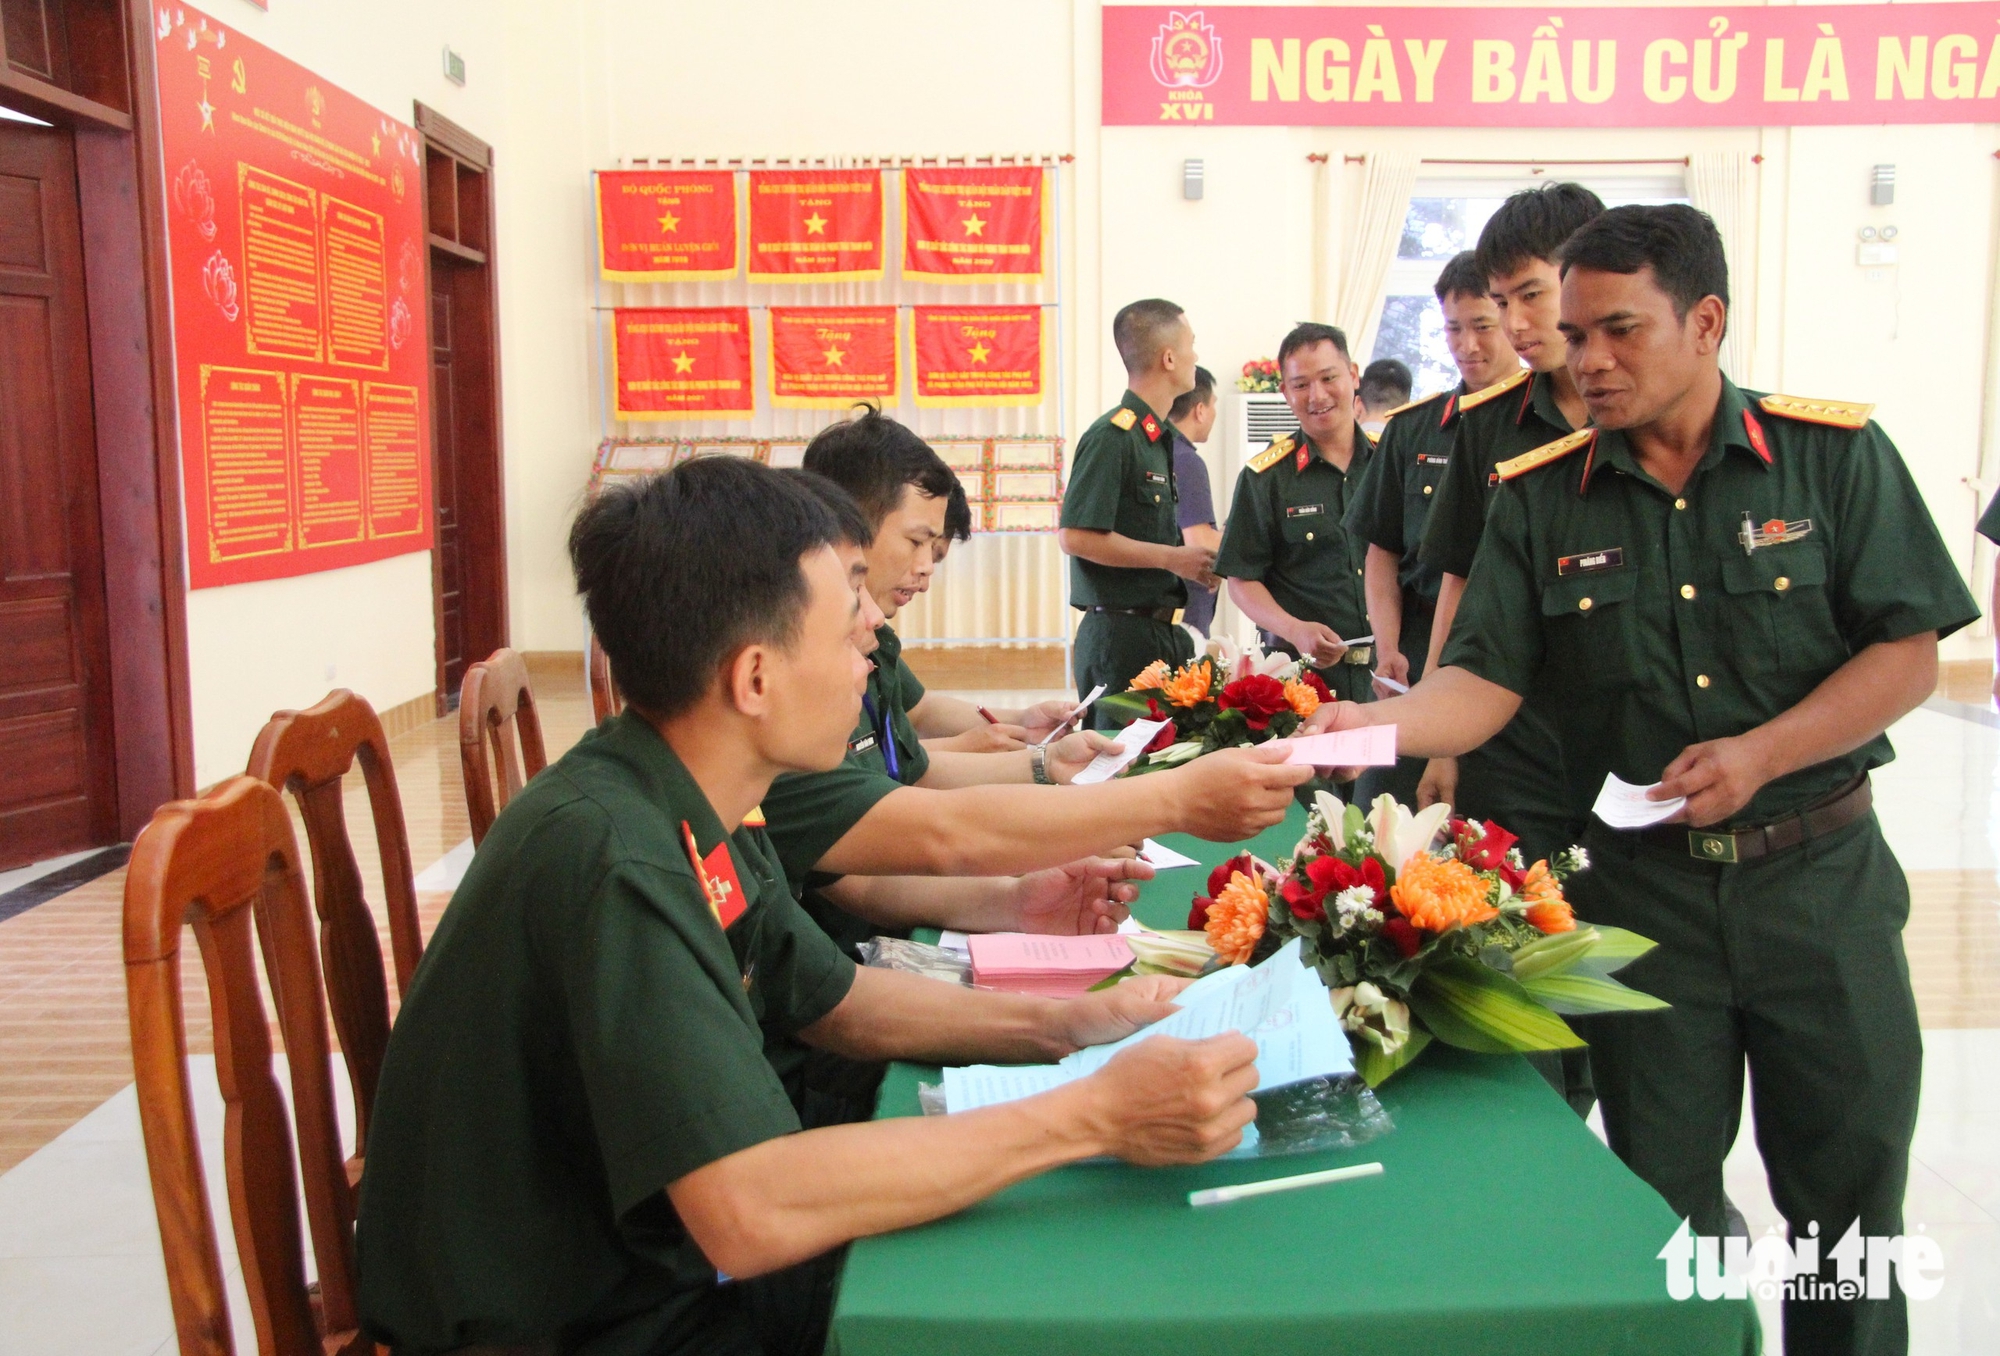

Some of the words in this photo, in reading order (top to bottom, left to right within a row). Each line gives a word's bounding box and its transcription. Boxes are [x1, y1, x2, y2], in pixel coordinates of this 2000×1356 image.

[1251, 25, 1448, 103] NGÀY
[1472, 16, 1617, 104] BẦU
[1643, 16, 1748, 104] CỬ
[1764, 23, 1850, 102] LÀ
[1168, 88, 1204, 101] KHÓA
[1160, 103, 1214, 120] XVI
